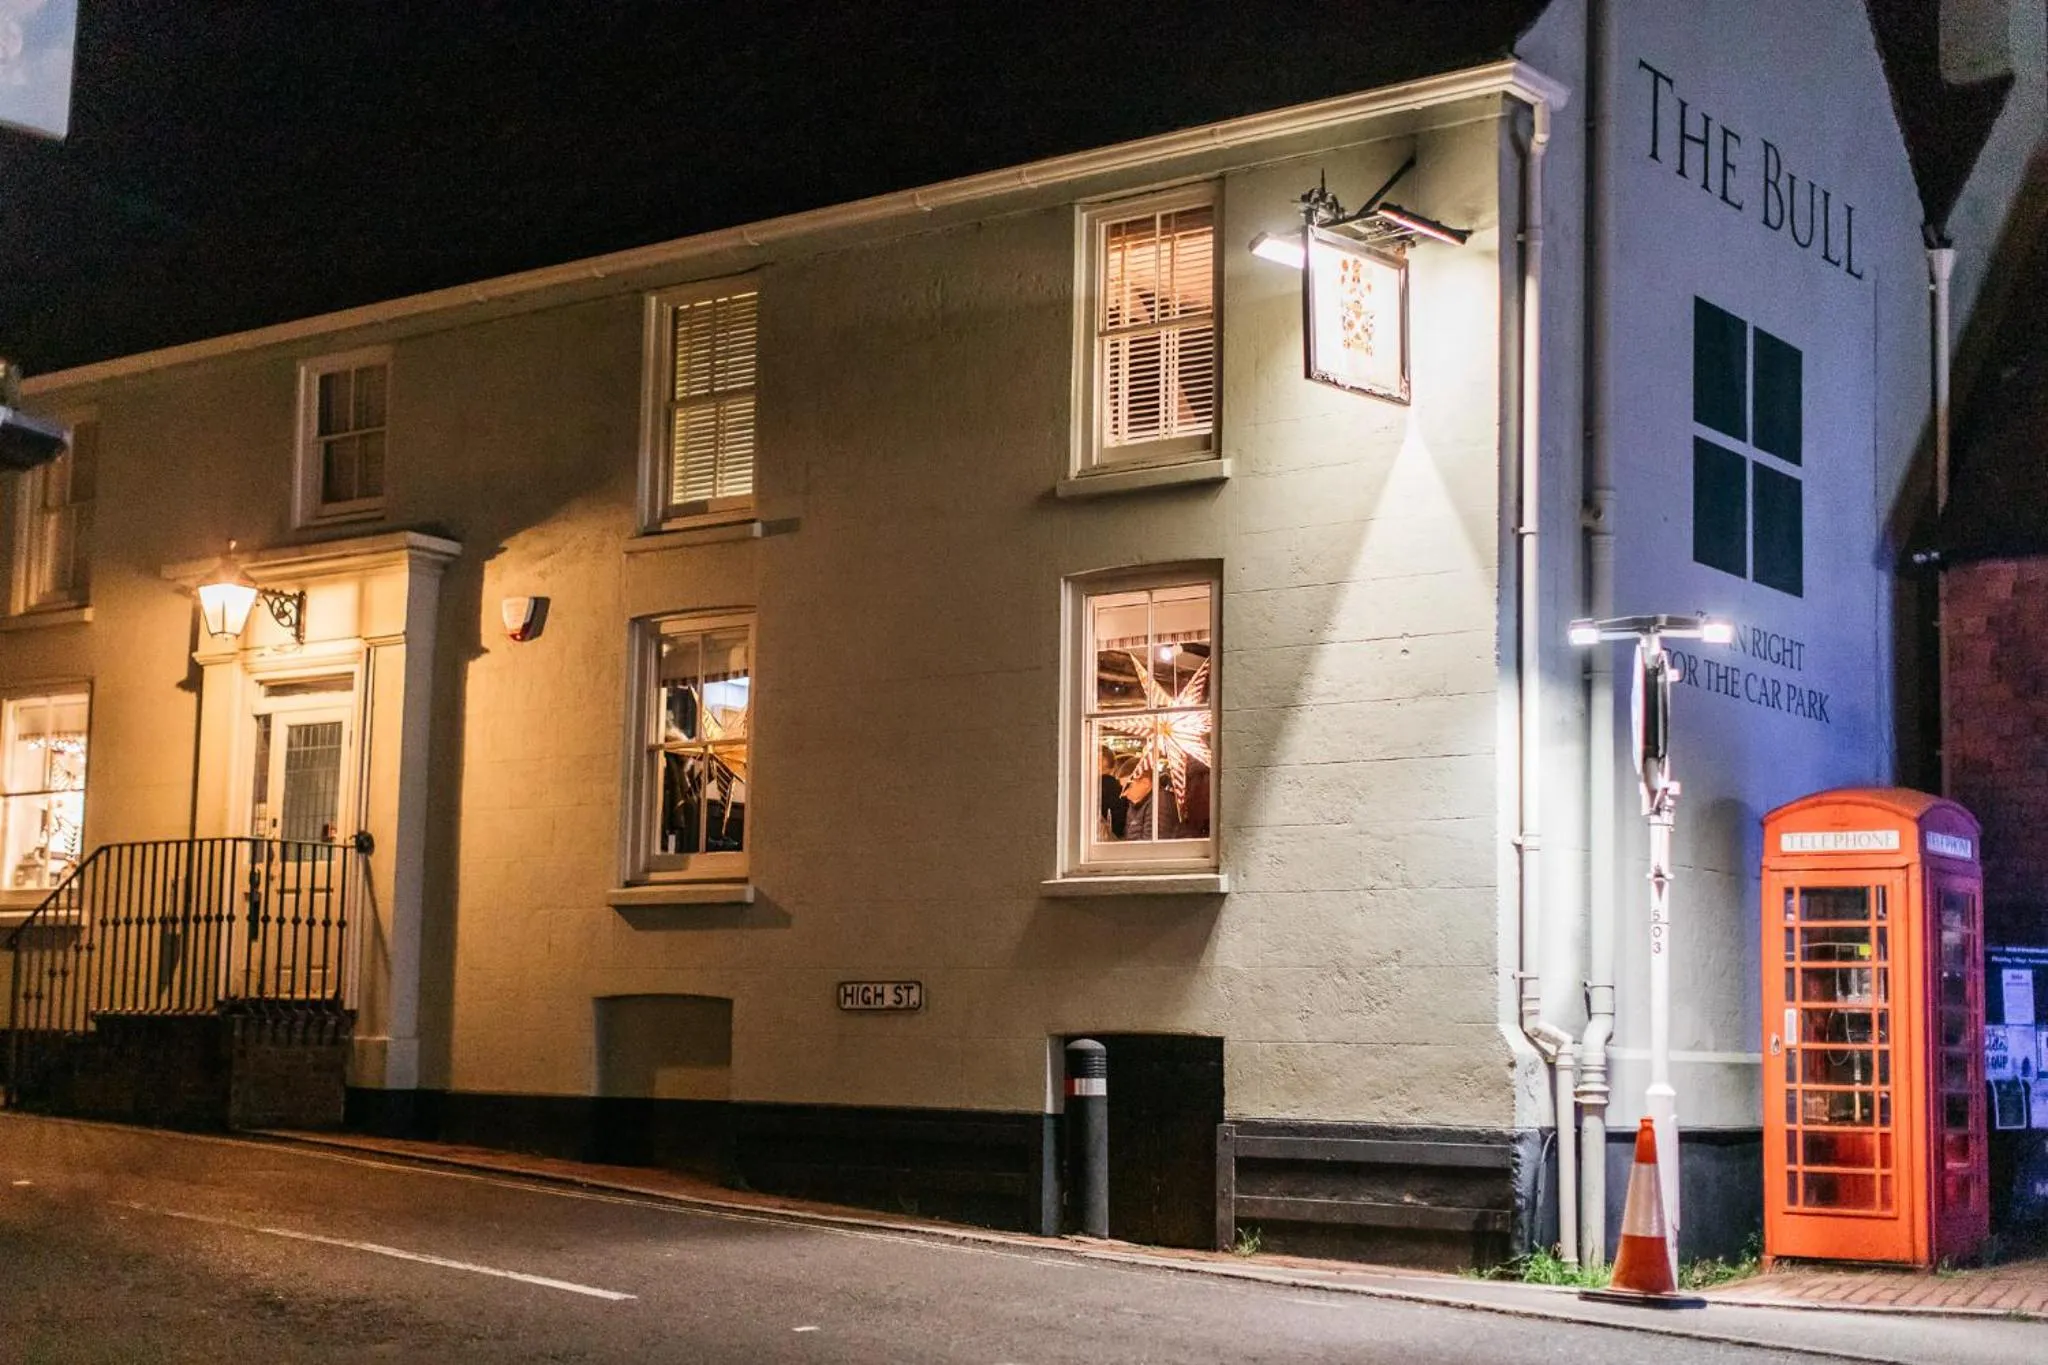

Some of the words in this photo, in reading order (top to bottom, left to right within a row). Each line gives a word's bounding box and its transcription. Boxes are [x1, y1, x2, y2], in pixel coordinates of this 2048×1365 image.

[1638, 57, 1744, 212] THE
[1761, 137, 1864, 281] BULL
[1752, 627, 1805, 672] RIGHT
[1704, 659, 1741, 699] THE
[1745, 671, 1782, 712] CAR
[1787, 684, 1831, 724] PARK
[1788, 833, 1893, 850] TELEPHONE
[843, 986, 885, 1006] HIGH
